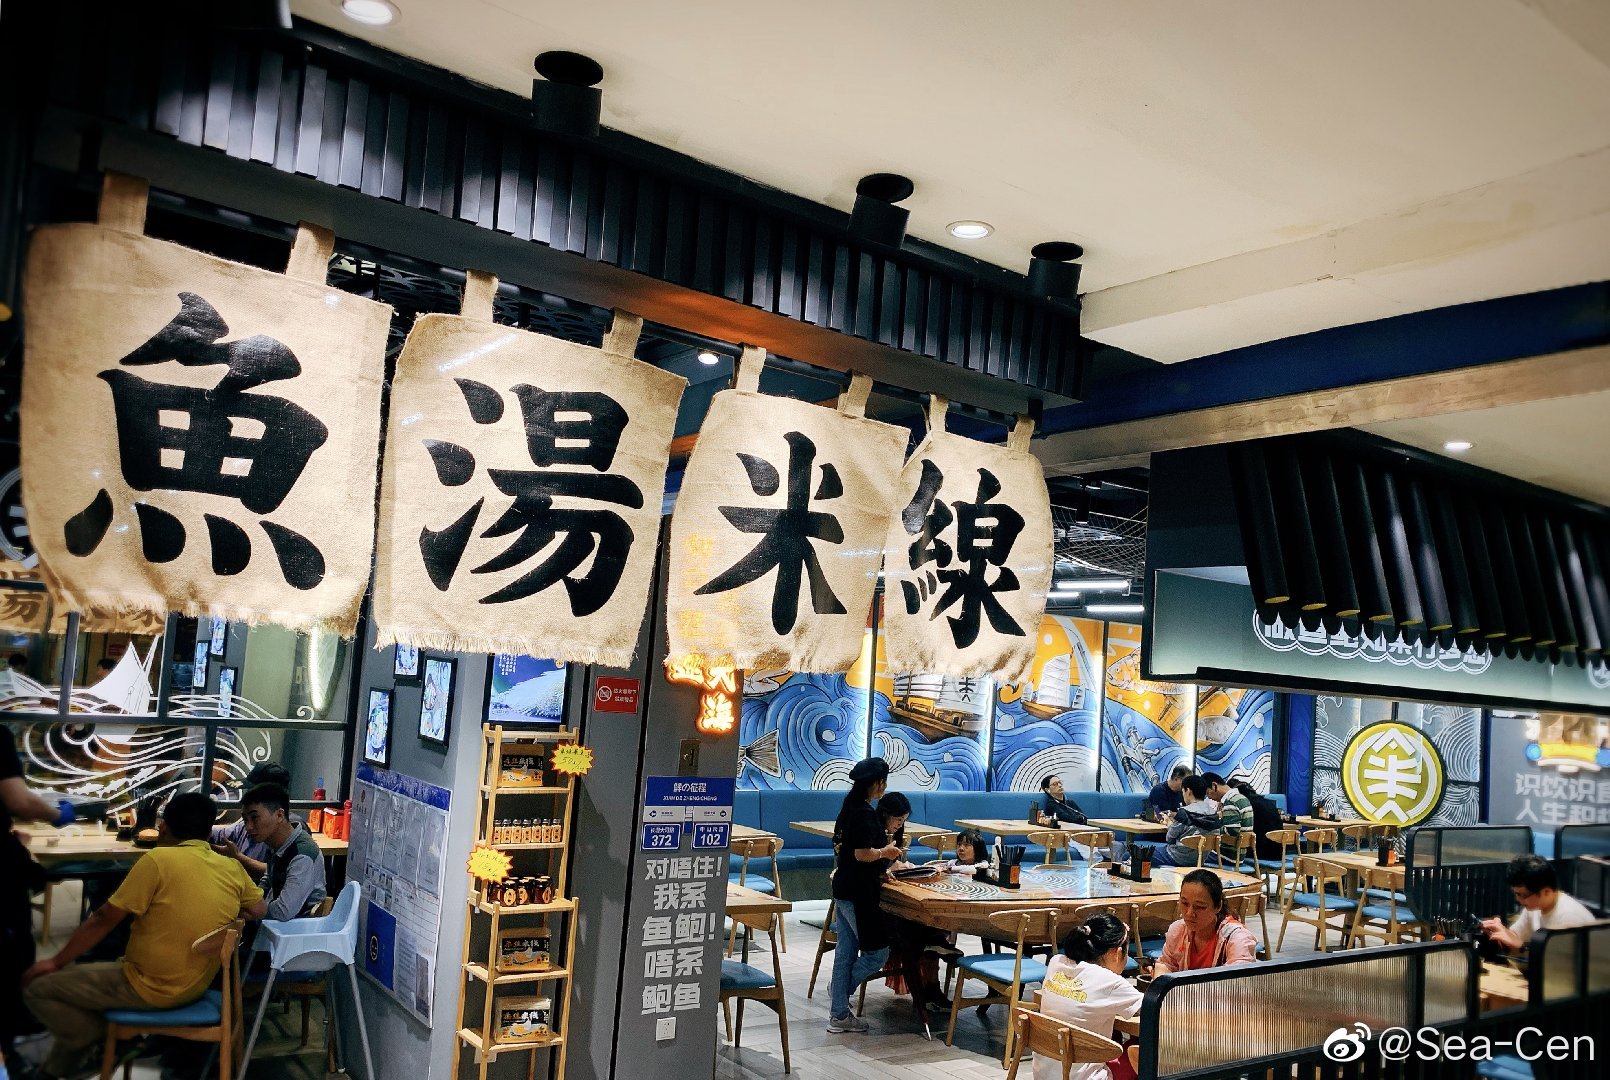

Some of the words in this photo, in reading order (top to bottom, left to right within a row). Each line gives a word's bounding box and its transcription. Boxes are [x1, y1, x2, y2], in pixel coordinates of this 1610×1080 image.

[64, 291, 1028, 650] 魚湯米線
[651, 835, 672, 847] 372
[700, 833, 721, 845] 102
[644, 857, 721, 880] 对唔住!
[653, 881, 707, 910] 我系
[641, 913, 715, 947] 鱼鲍!
[644, 946, 704, 978] 唔系
[640, 982, 701, 1016] 鲍鱼
